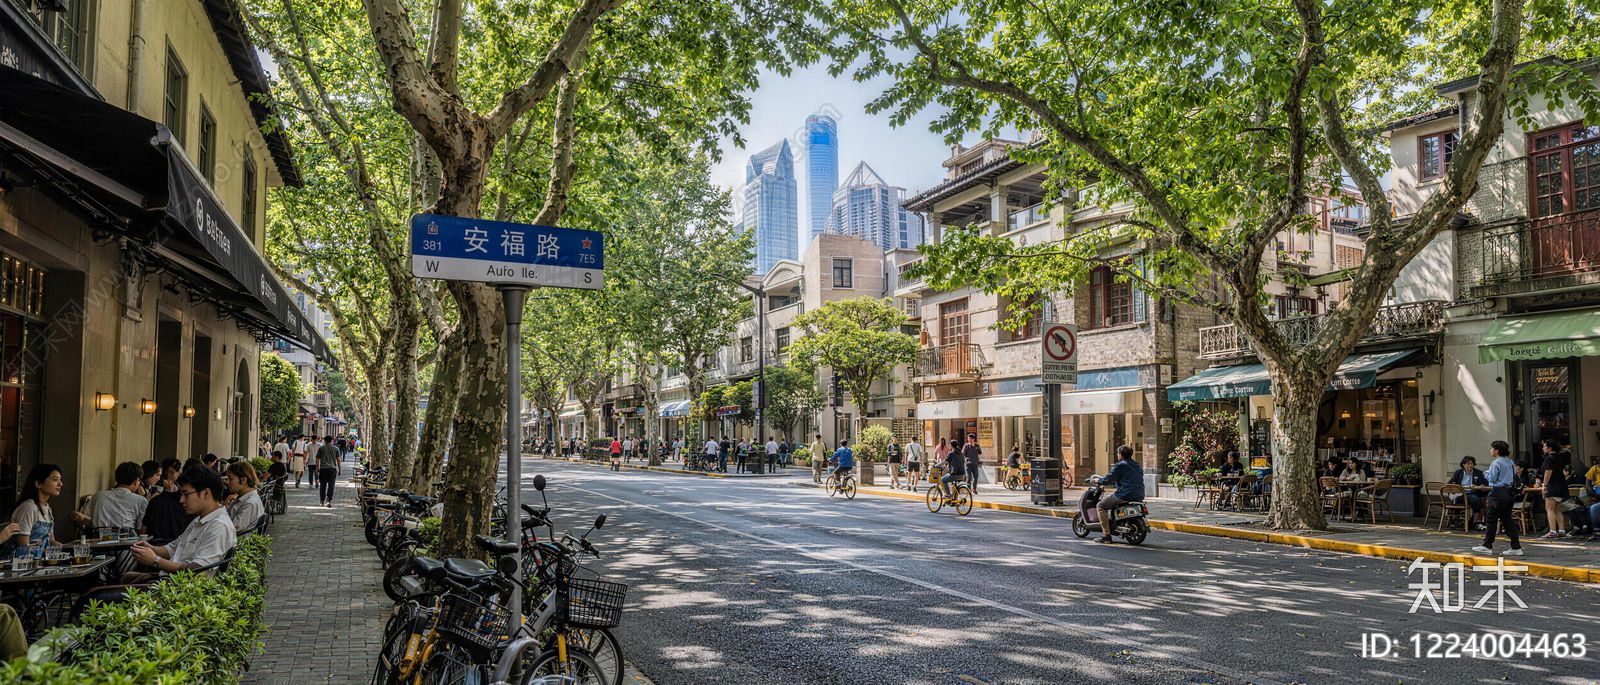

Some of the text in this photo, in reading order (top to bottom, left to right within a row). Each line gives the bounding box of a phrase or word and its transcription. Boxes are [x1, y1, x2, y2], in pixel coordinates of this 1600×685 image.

[423, 239, 442, 251] 381
[463, 226, 560, 260] 安福路
[578, 253, 595, 264] 7E5
[425, 260, 440, 273] W
[583, 272, 592, 284] S
